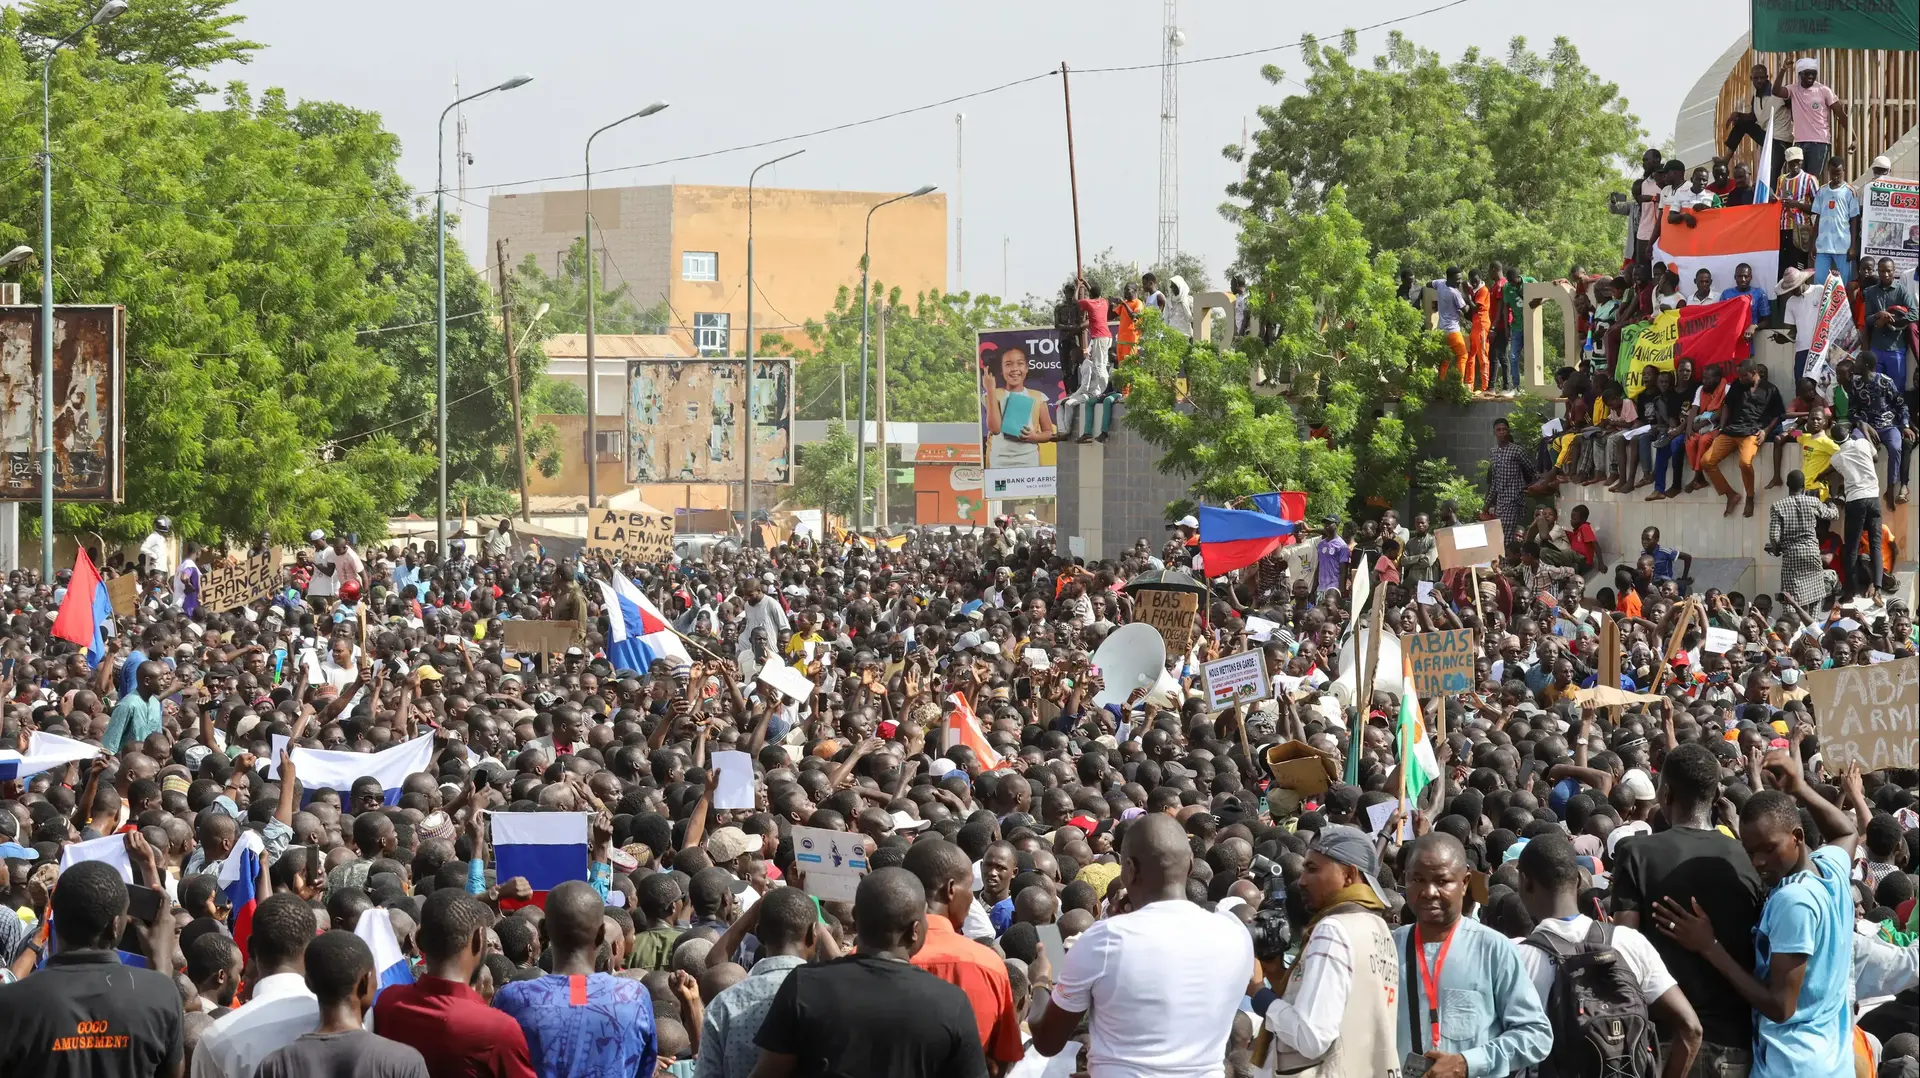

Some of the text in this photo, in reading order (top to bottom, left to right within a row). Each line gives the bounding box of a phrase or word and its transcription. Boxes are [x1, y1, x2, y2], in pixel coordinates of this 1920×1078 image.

[1873, 182, 1912, 191] GROUPE
[1872, 191, 1889, 202] B-52
[1893, 194, 1917, 208] B-52
[595, 526, 675, 547] LA FRANCE
[623, 543, 649, 553] NON
[250, 551, 272, 571] LA
[202, 569, 270, 600] FRANCE
[224, 592, 249, 608] SES
[1135, 592, 1181, 609] A BAS
[1133, 609, 1195, 629] LA FRANCE
[1208, 667, 1219, 677] NOUS
[1219, 664, 1236, 676] METTONS
[1243, 658, 1255, 669] GARDE
[52, 1035, 129, 1051] AMUSEMENT
